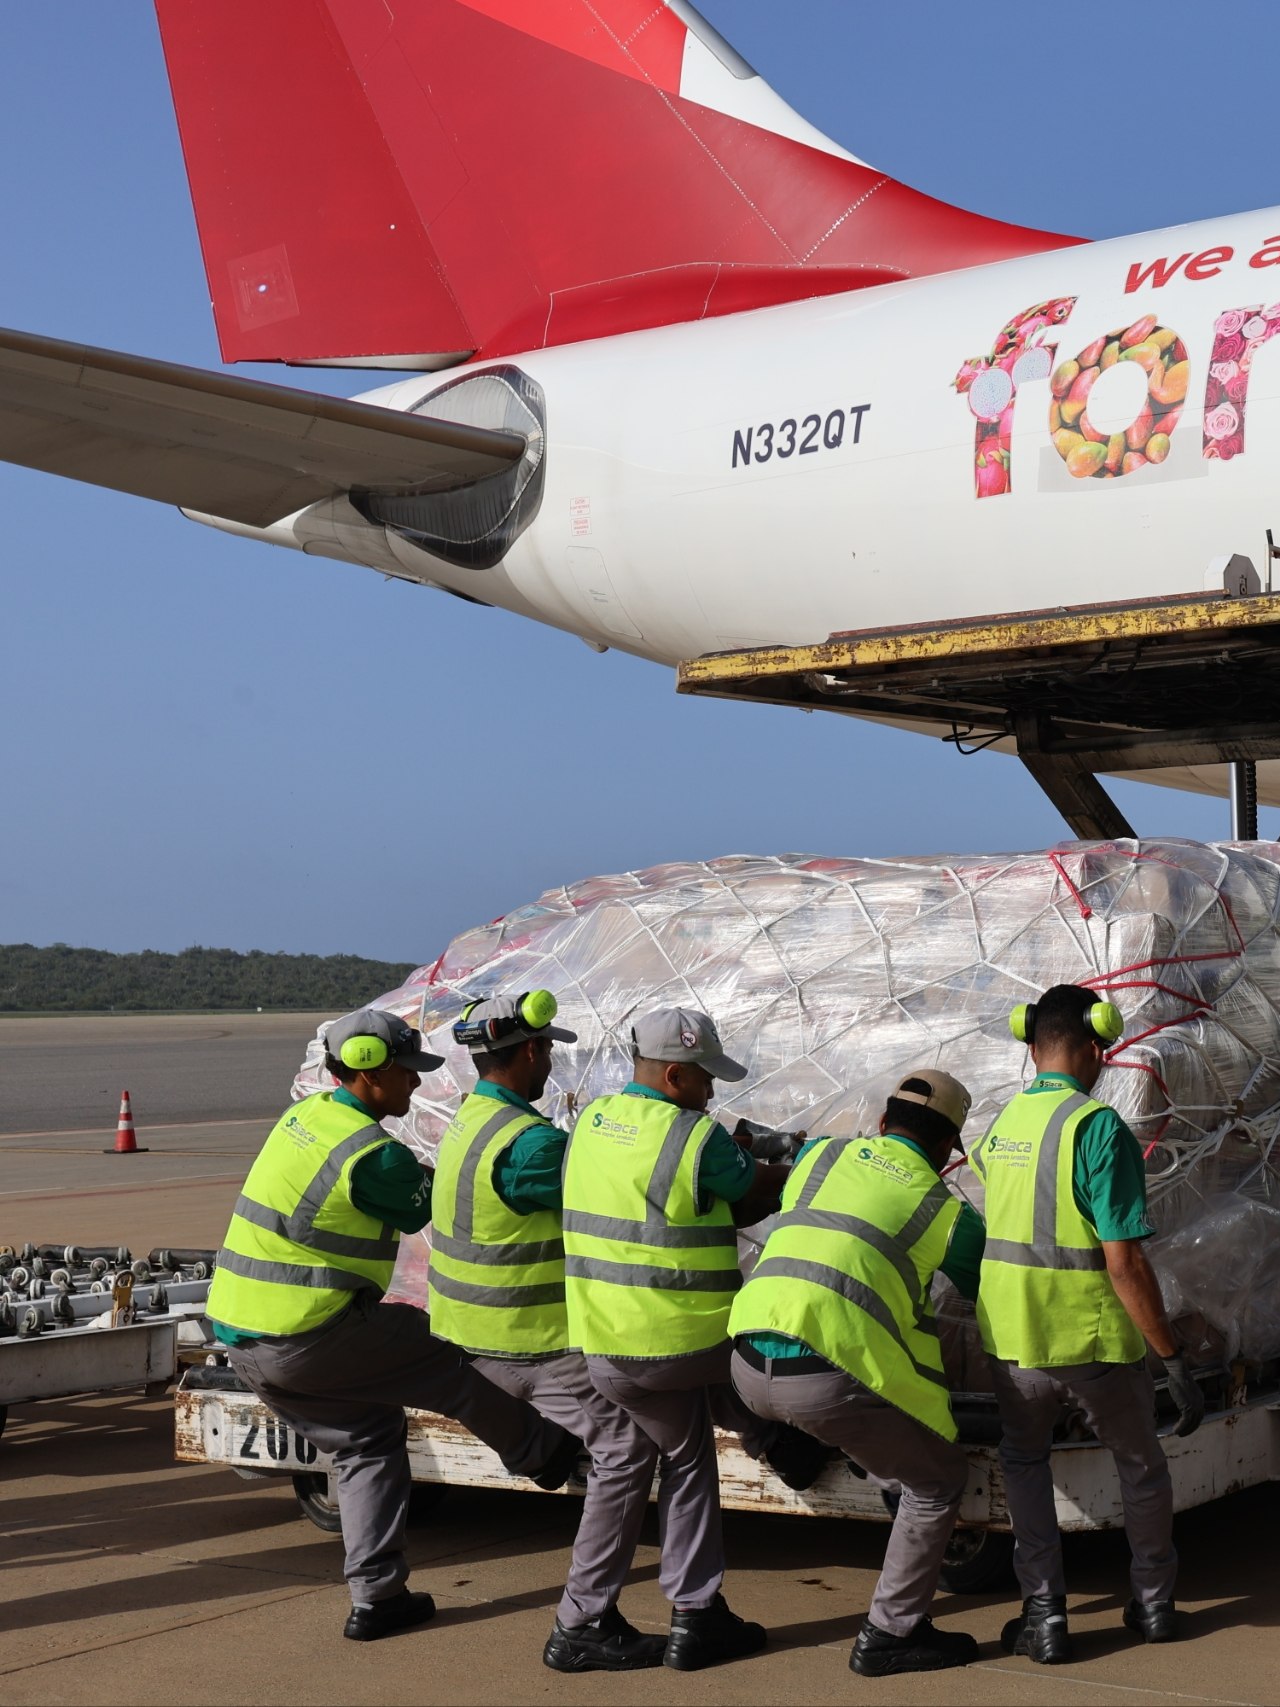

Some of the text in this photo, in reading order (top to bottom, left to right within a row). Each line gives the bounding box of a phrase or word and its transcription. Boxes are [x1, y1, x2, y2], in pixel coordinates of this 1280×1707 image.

[1123, 245, 1235, 294] we
[732, 403, 871, 468] N332QT
[291, 1121, 317, 1143] Siaca
[602, 1117, 638, 1135] Siaca
[995, 1137, 1032, 1153] Siaca
[870, 1154, 913, 1181] Siaca
